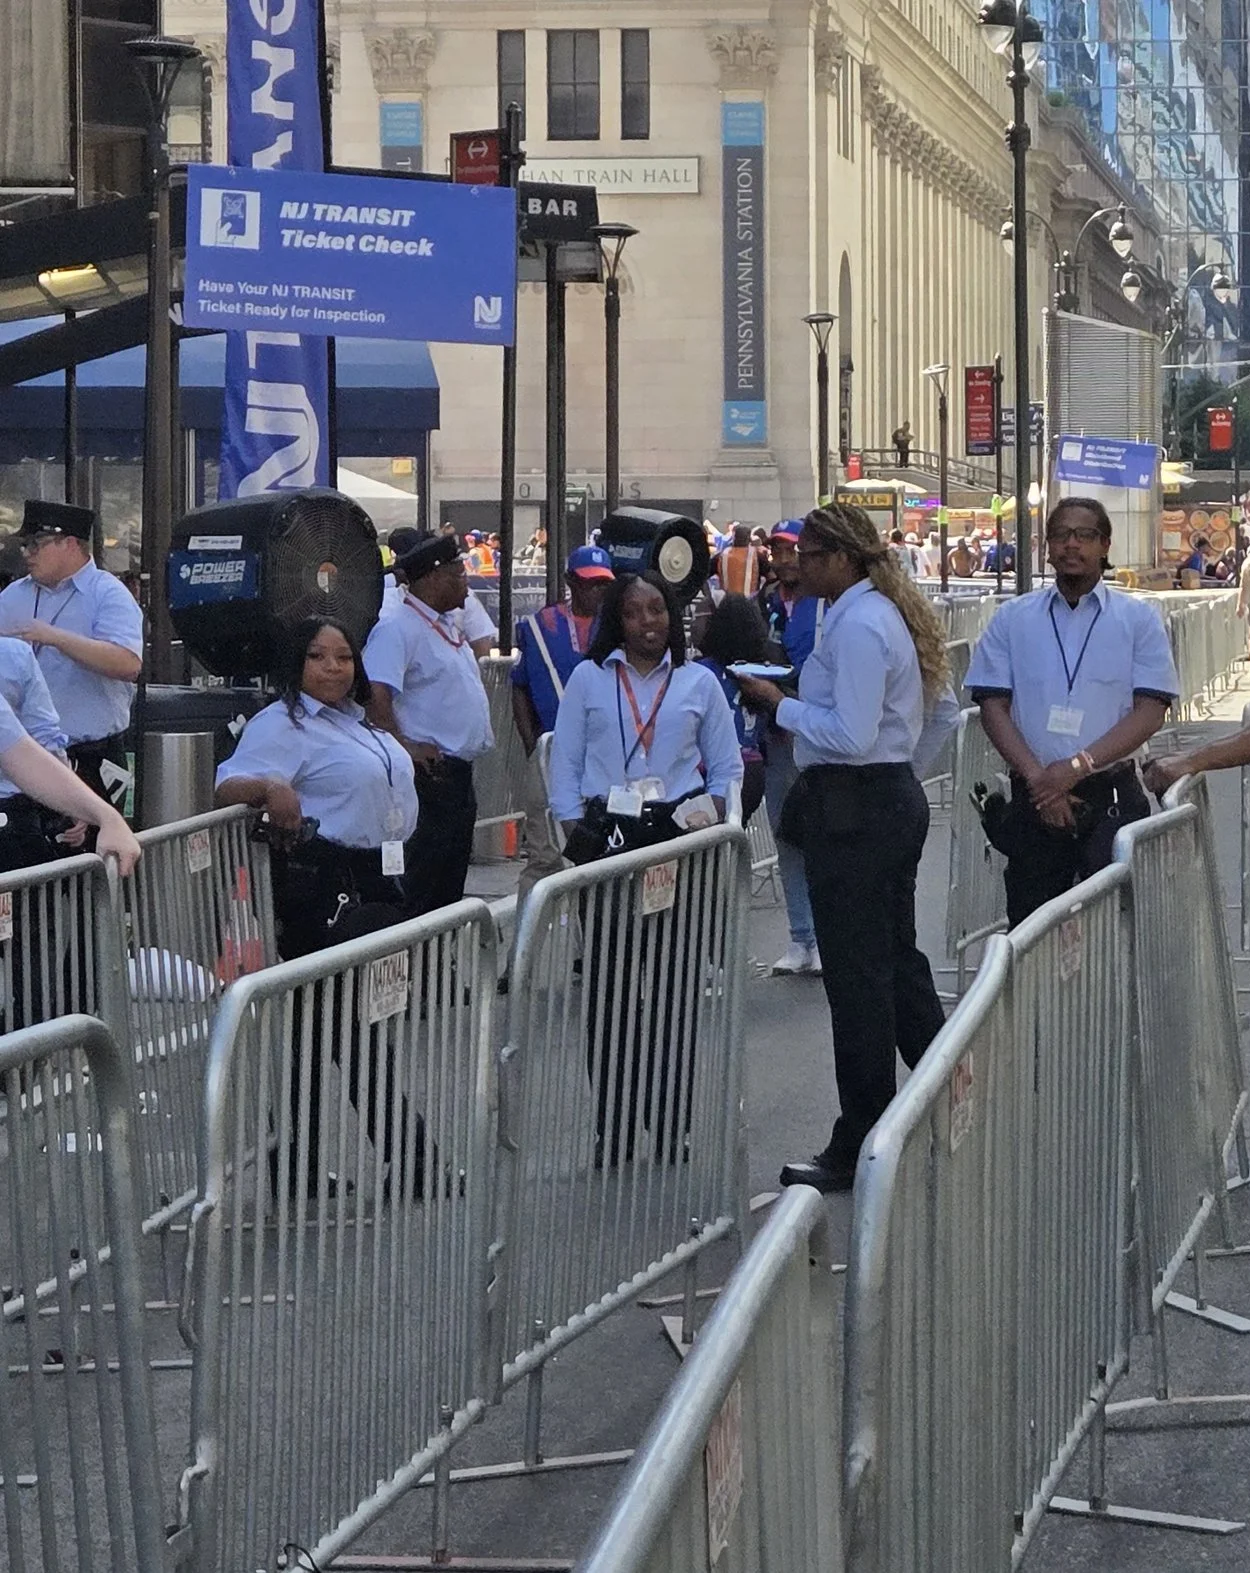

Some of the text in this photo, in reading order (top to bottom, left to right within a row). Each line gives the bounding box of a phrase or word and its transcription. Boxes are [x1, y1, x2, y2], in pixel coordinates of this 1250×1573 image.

[573, 168, 634, 184] TRAIN
[643, 169, 693, 183] HALL
[279, 201, 416, 227] NJ TRANSIT
[528, 198, 578, 217] BAR
[280, 229, 435, 257] Ticket Check
[737, 157, 754, 389] PENNSYLVANIA STATION
[199, 279, 356, 302] Have Your NJ TRANSIT
[199, 298, 241, 314] Ticket
[244, 302, 288, 320] Ready
[291, 304, 310, 319] for
[313, 306, 386, 324] Inspection
[840, 494, 875, 504] TAXI
[192, 560, 246, 576] POWER
